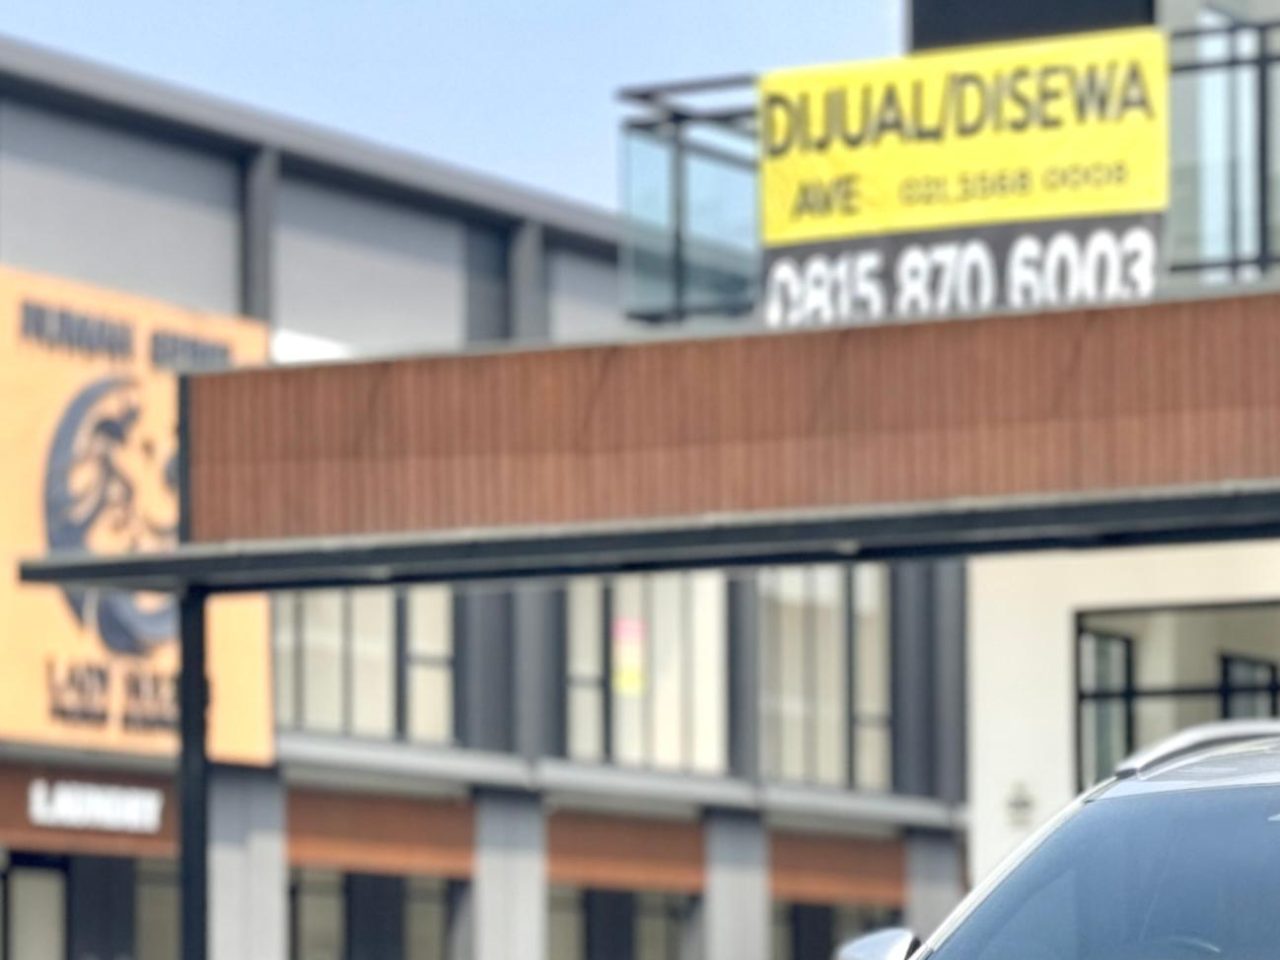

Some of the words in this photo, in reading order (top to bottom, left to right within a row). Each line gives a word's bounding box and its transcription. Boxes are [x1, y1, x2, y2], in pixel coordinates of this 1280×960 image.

[764, 59, 1155, 158] DIJUAL/DISEWA
[766, 251, 886, 327] 0815
[896, 240, 995, 318] 870
[1005, 228, 1156, 309] 6003
